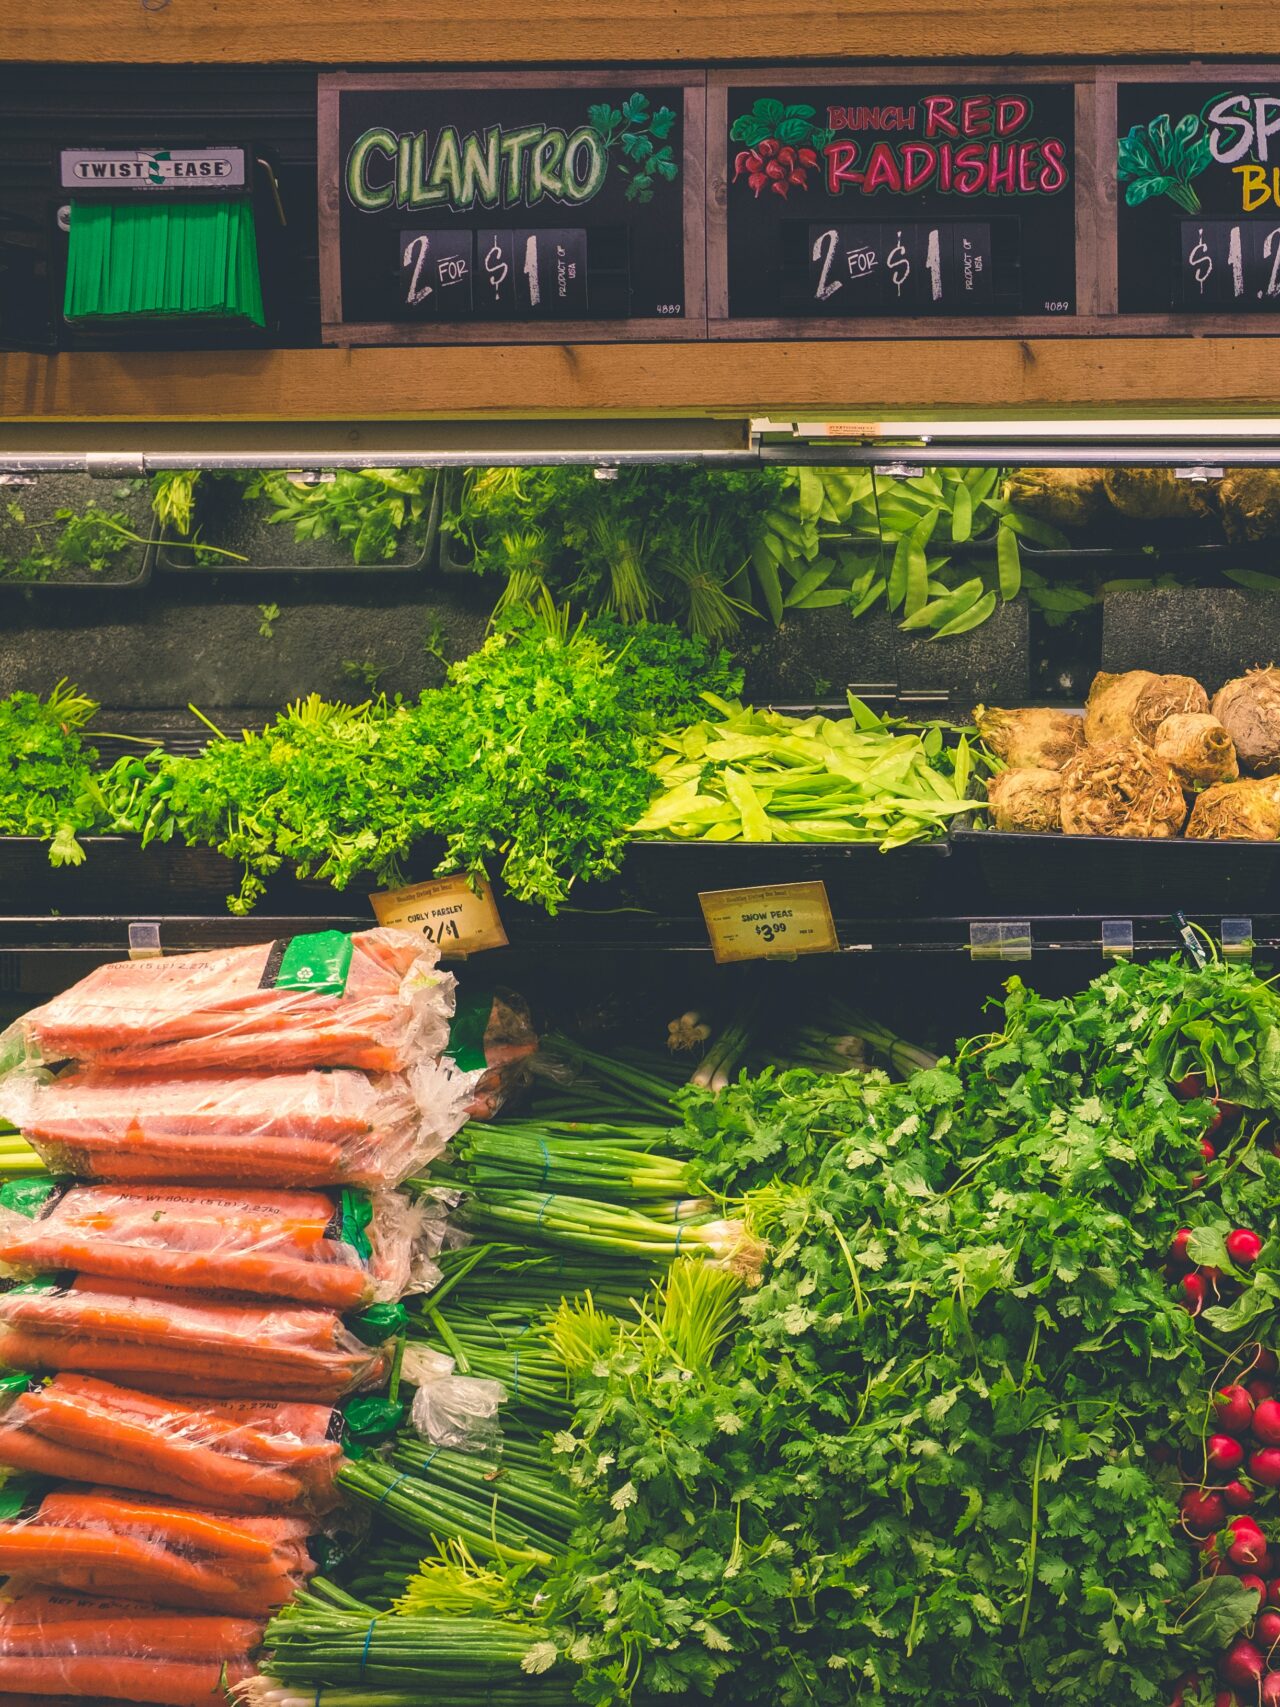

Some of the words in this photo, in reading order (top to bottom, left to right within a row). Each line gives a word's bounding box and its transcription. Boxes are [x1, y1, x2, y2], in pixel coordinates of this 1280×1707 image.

[827, 106, 916, 131] BUNCH
[921, 95, 1030, 138] RED
[346, 124, 608, 212] CILANTRO
[824, 139, 1068, 195] RADISHES
[557, 246, 566, 257] OF
[963, 239, 972, 250] OF
[404, 236, 433, 306] 2
[437, 256, 469, 284] FOR
[568, 262, 577, 279] USA
[812, 230, 843, 300] 2
[847, 250, 878, 277] FOR
[965, 254, 973, 290] PRODUCT
[974, 255, 983, 272] USA
[559, 260, 567, 297] PRODUCT
[656, 304, 681, 314] 4889
[1044, 301, 1069, 311] 4089
[407, 911, 430, 923] CURLY
[431, 904, 463, 918] PARSLEY
[741, 912, 767, 922] SNOW
[770, 909, 793, 919] PEAS
